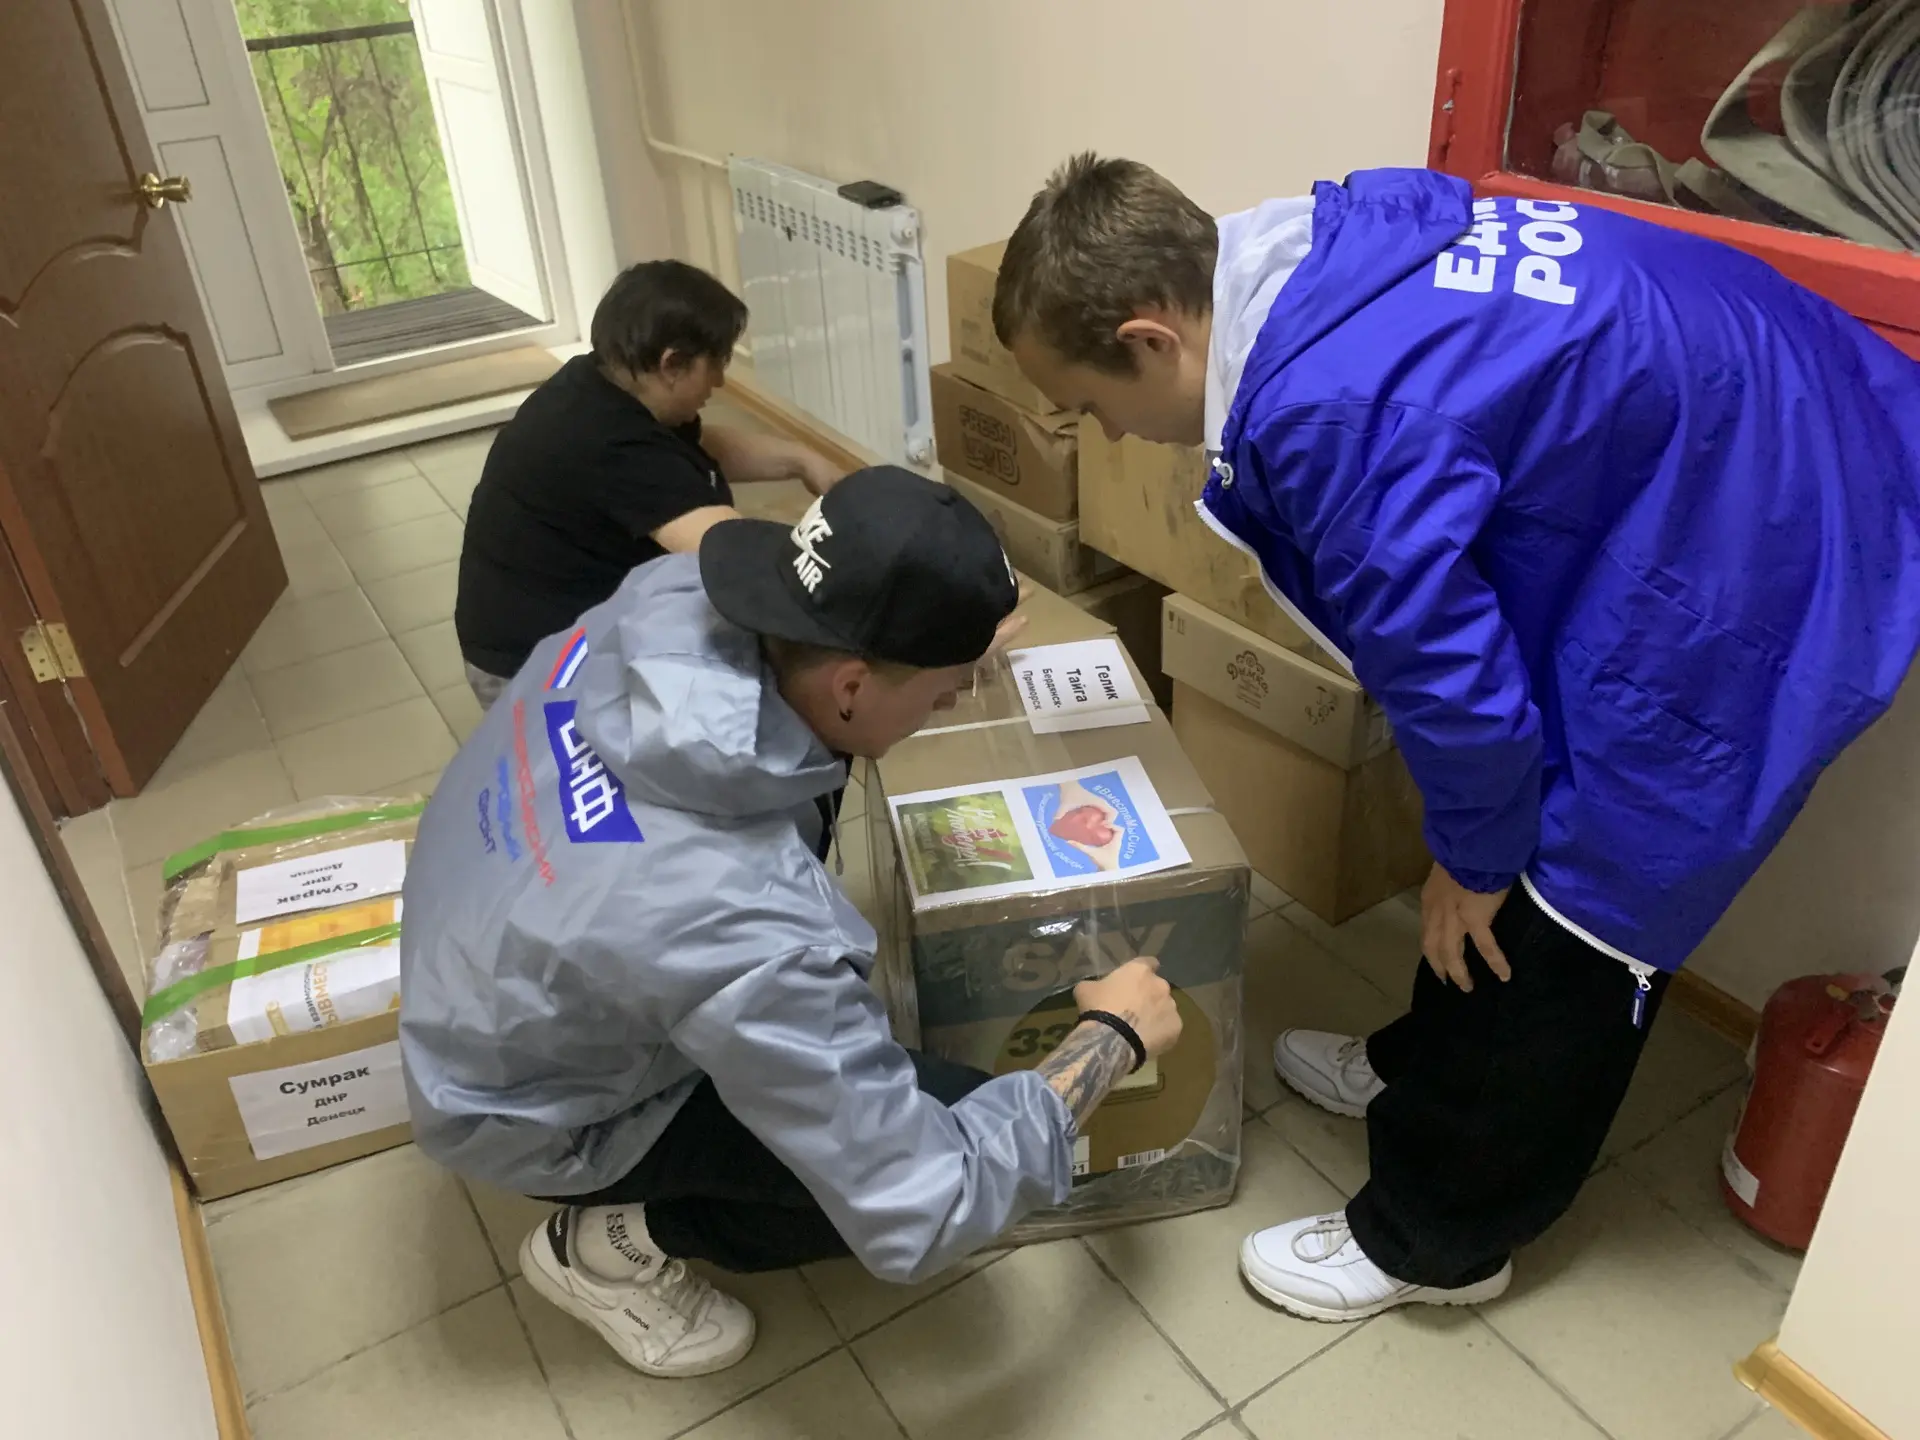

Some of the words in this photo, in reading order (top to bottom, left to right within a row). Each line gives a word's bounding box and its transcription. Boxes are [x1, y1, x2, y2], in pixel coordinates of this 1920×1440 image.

[793, 551, 823, 594] AIR
[1022, 669, 1042, 710] Приморск
[1066, 668, 1088, 703] Тайга
[1094, 664, 1119, 700] Гелик
[276, 882, 359, 905] Сумрак
[279, 1066, 371, 1095] Сумрак
[314, 1092, 348, 1109] ДНР
[306, 1105, 367, 1127] Донецк
[623, 1307, 651, 1331] Reebok
